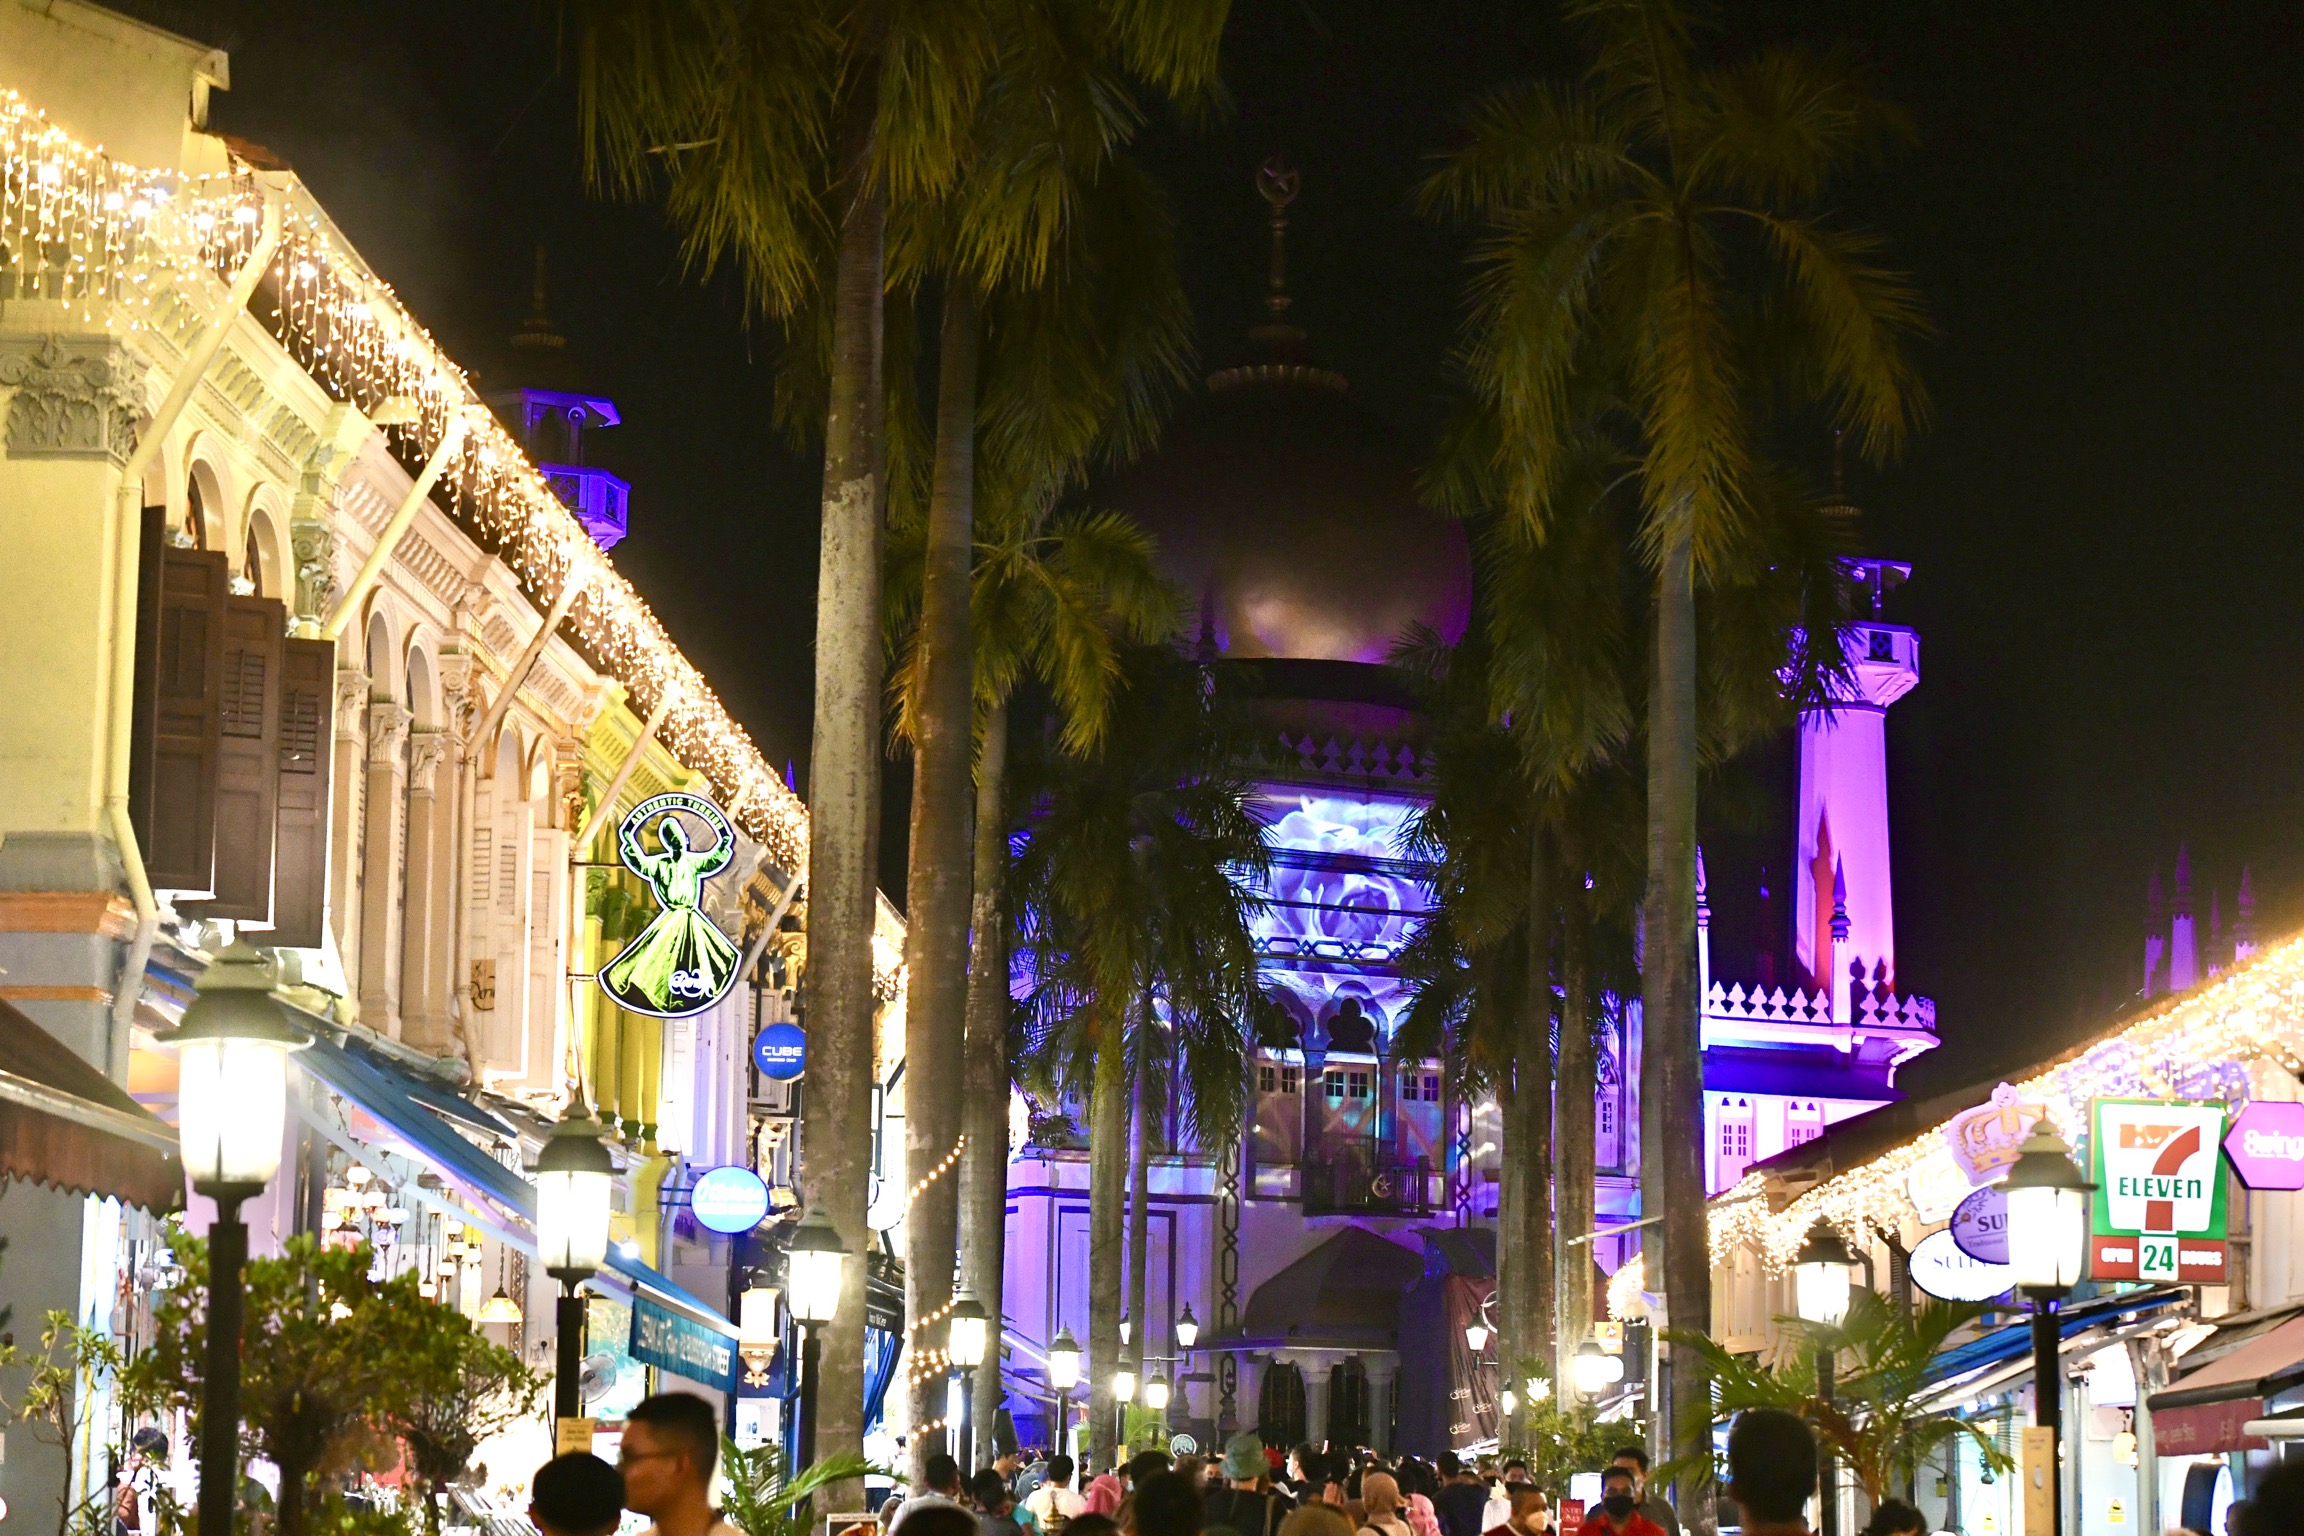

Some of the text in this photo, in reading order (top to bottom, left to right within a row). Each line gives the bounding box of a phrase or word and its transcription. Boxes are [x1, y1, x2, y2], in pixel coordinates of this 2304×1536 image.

[631, 797, 724, 830] AUTHENTIC TURKISH
[761, 1045, 803, 1057] CUBE
[1977, 1212, 2008, 1233] SU
[2143, 1244, 2174, 1272] 24
